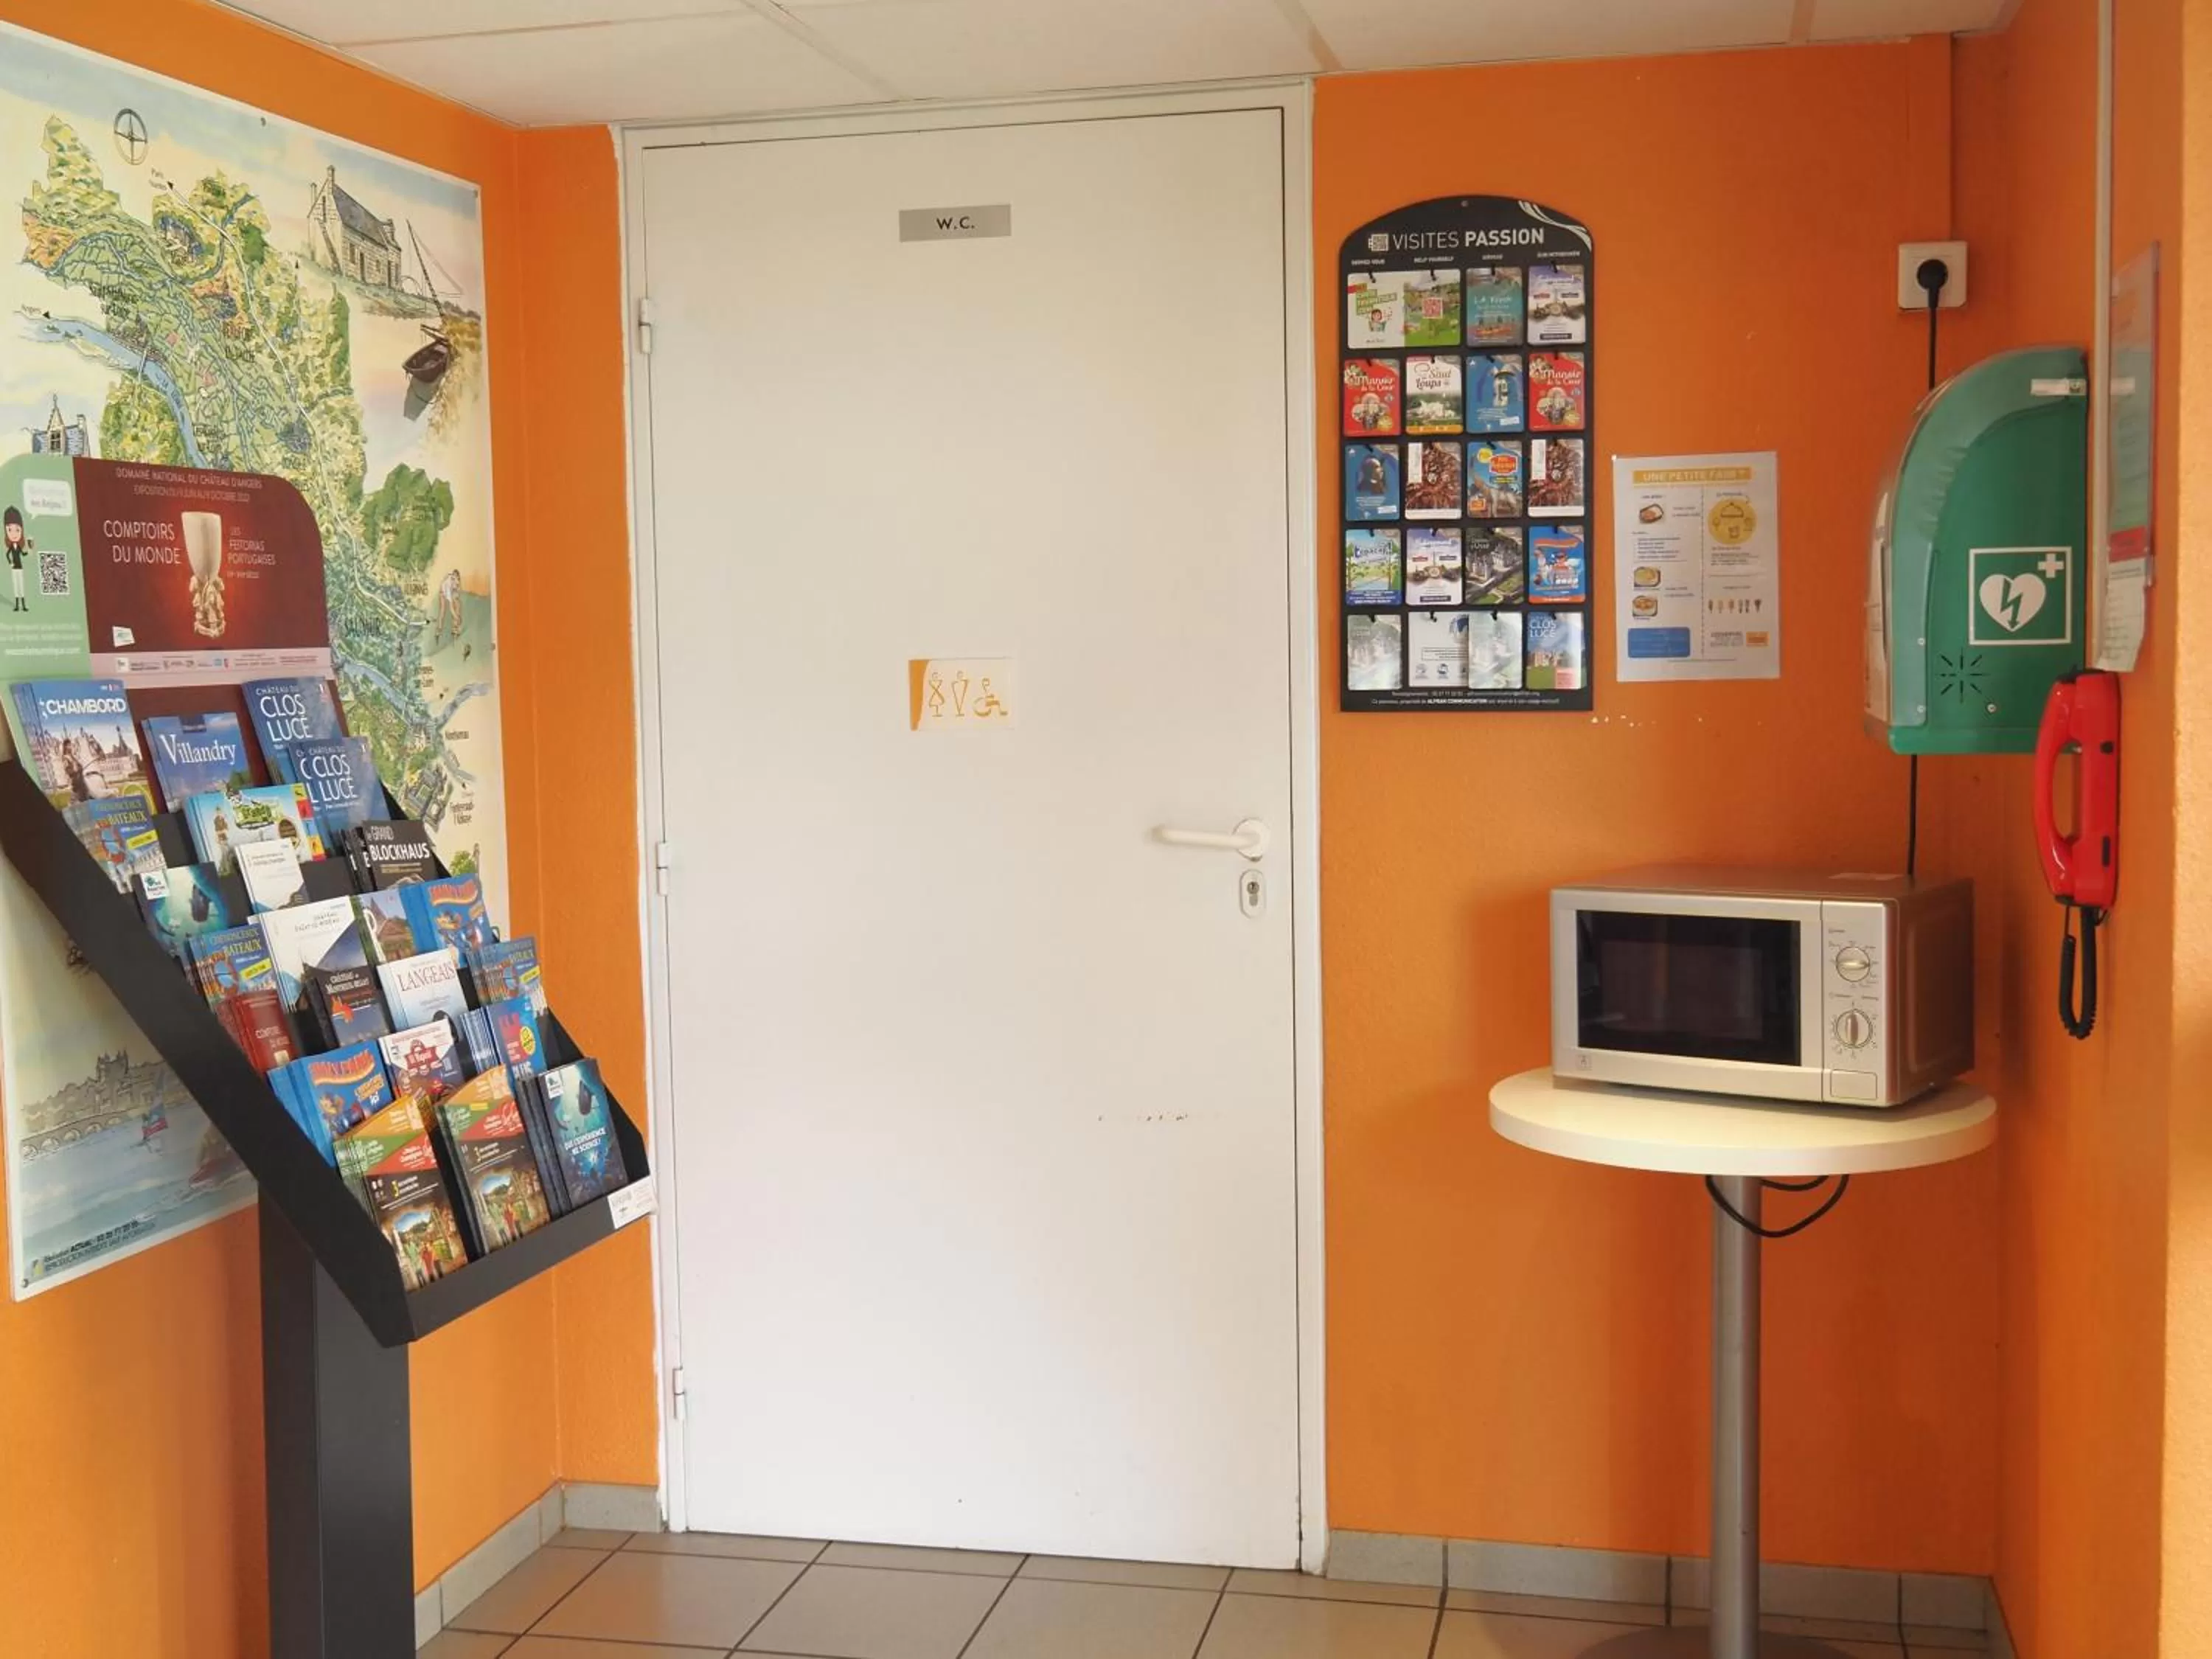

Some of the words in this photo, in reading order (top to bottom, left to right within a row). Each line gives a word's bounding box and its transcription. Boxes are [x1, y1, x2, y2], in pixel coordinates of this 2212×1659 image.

[936, 216, 975, 230] W.C.
[1393, 231, 1459, 250] VISITES
[1464, 228, 1545, 247] PASSION
[103, 520, 175, 540] COMPTOIRS
[112, 545, 131, 563] DU
[135, 546, 182, 564] MONDE
[46, 698, 127, 715] CHAMBORD
[260, 694, 306, 718] CLOS
[159, 733, 237, 765] Villandry
[312, 754, 350, 778] CLOS
[369, 842, 430, 861] BLOCKHAUS
